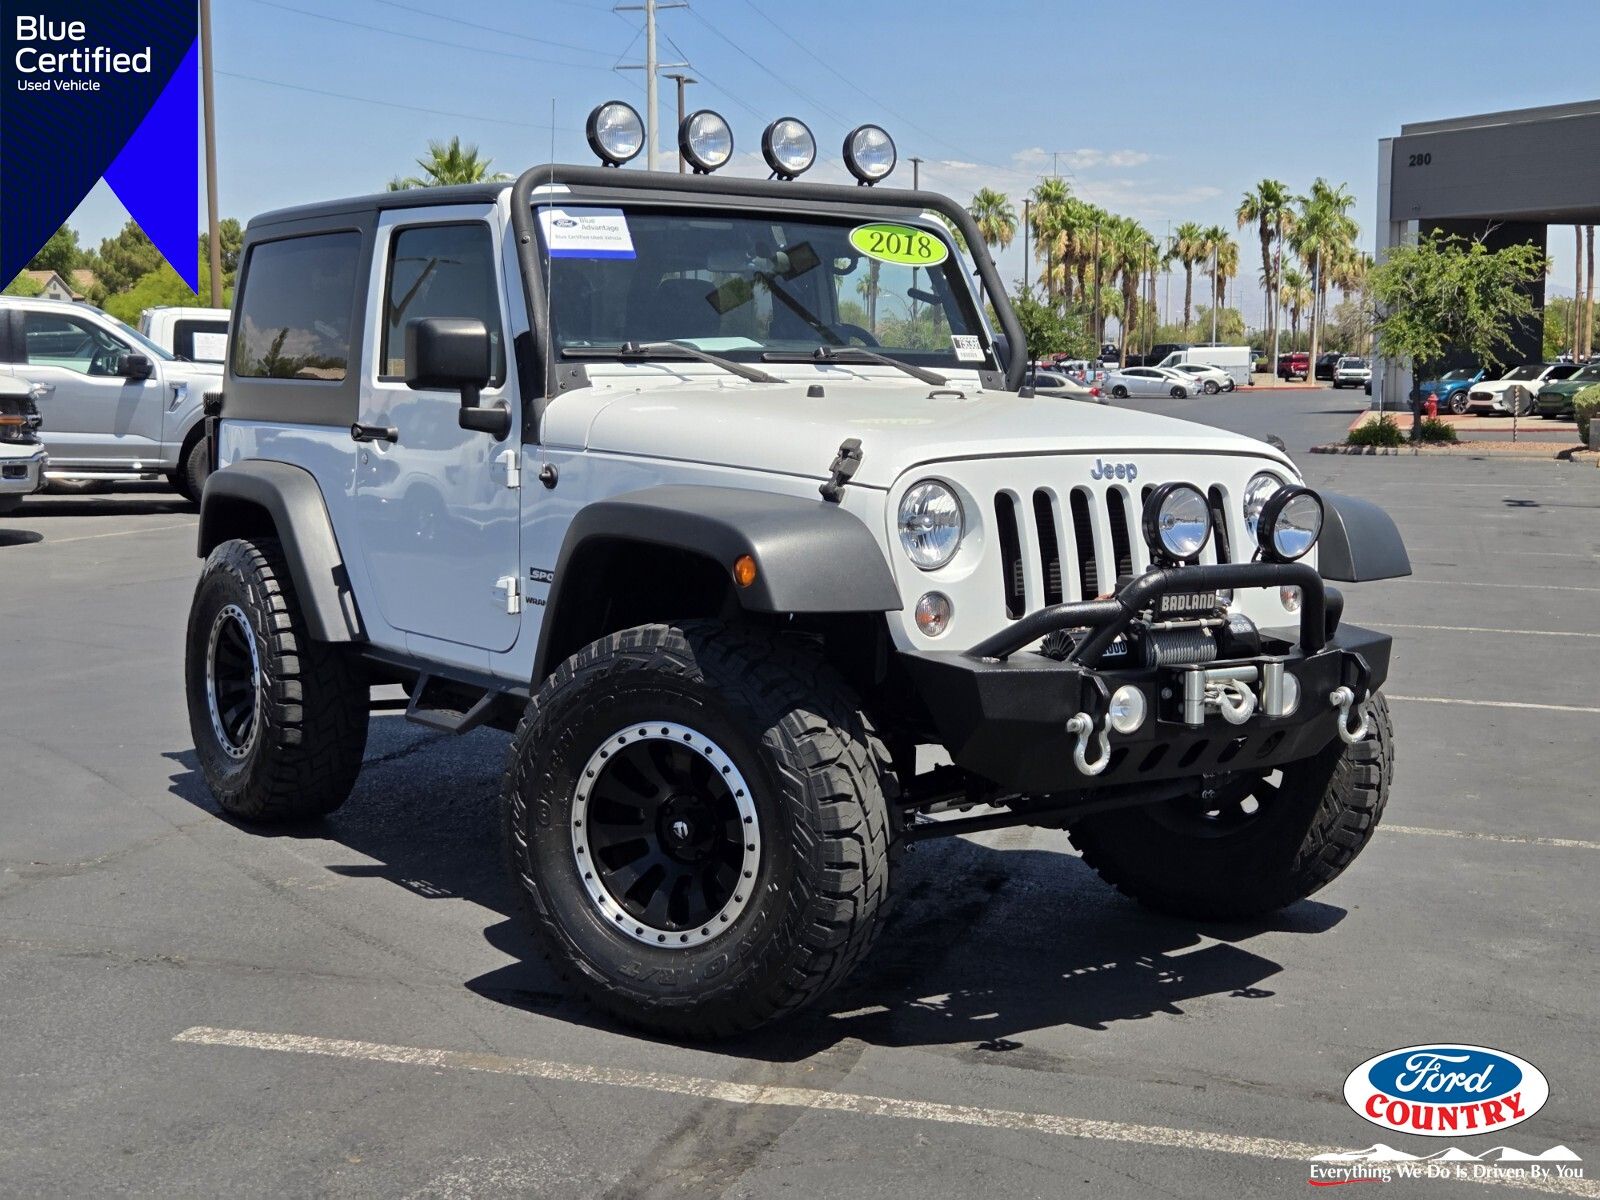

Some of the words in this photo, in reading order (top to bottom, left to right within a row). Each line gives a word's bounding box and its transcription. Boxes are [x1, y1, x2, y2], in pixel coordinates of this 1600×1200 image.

[1409, 153, 1432, 167] 280
[582, 225, 620, 233] Advantage
[869, 231, 932, 258] 2018
[1090, 459, 1138, 483] Jeep
[1161, 593, 1216, 612] BADLAND
